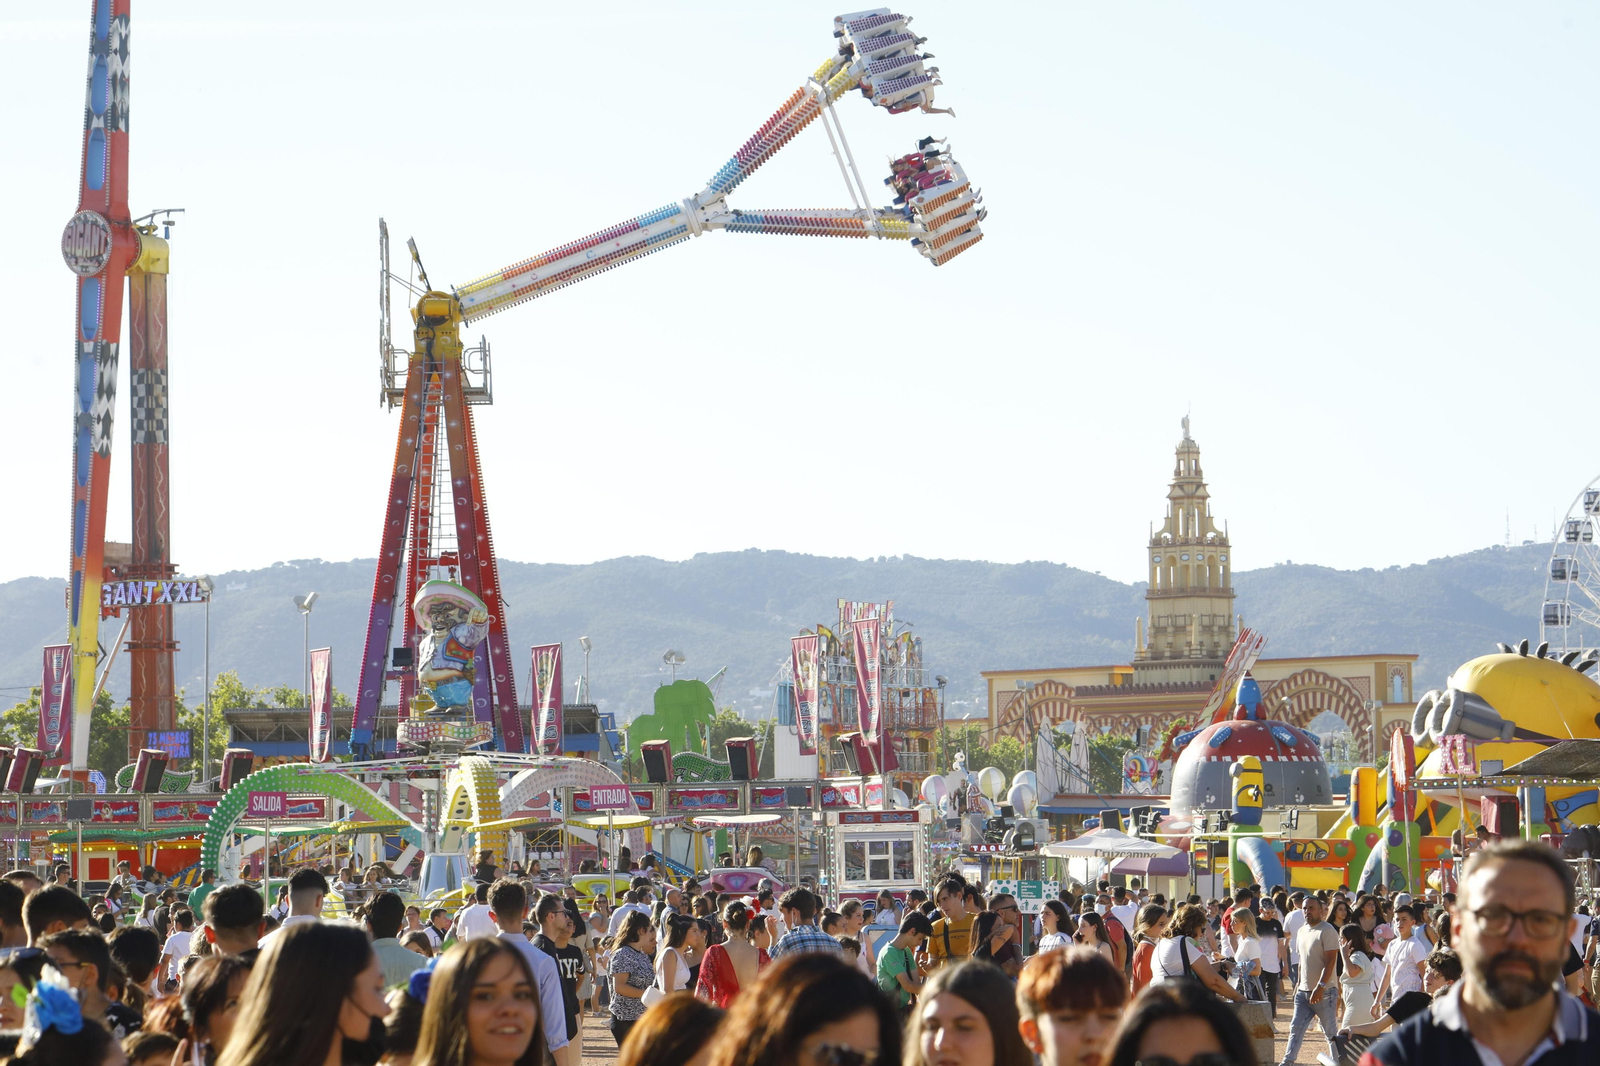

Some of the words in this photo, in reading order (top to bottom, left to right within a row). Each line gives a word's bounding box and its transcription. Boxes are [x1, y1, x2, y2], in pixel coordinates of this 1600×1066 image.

[64, 223, 108, 257] GIGANT
[159, 582, 202, 602] XXL
[1436, 734, 1476, 775] XL
[252, 795, 282, 812] SALIDA
[592, 789, 627, 805] ENTRADA
[845, 814, 874, 822] ZIG
[880, 813, 913, 822] ZAG
